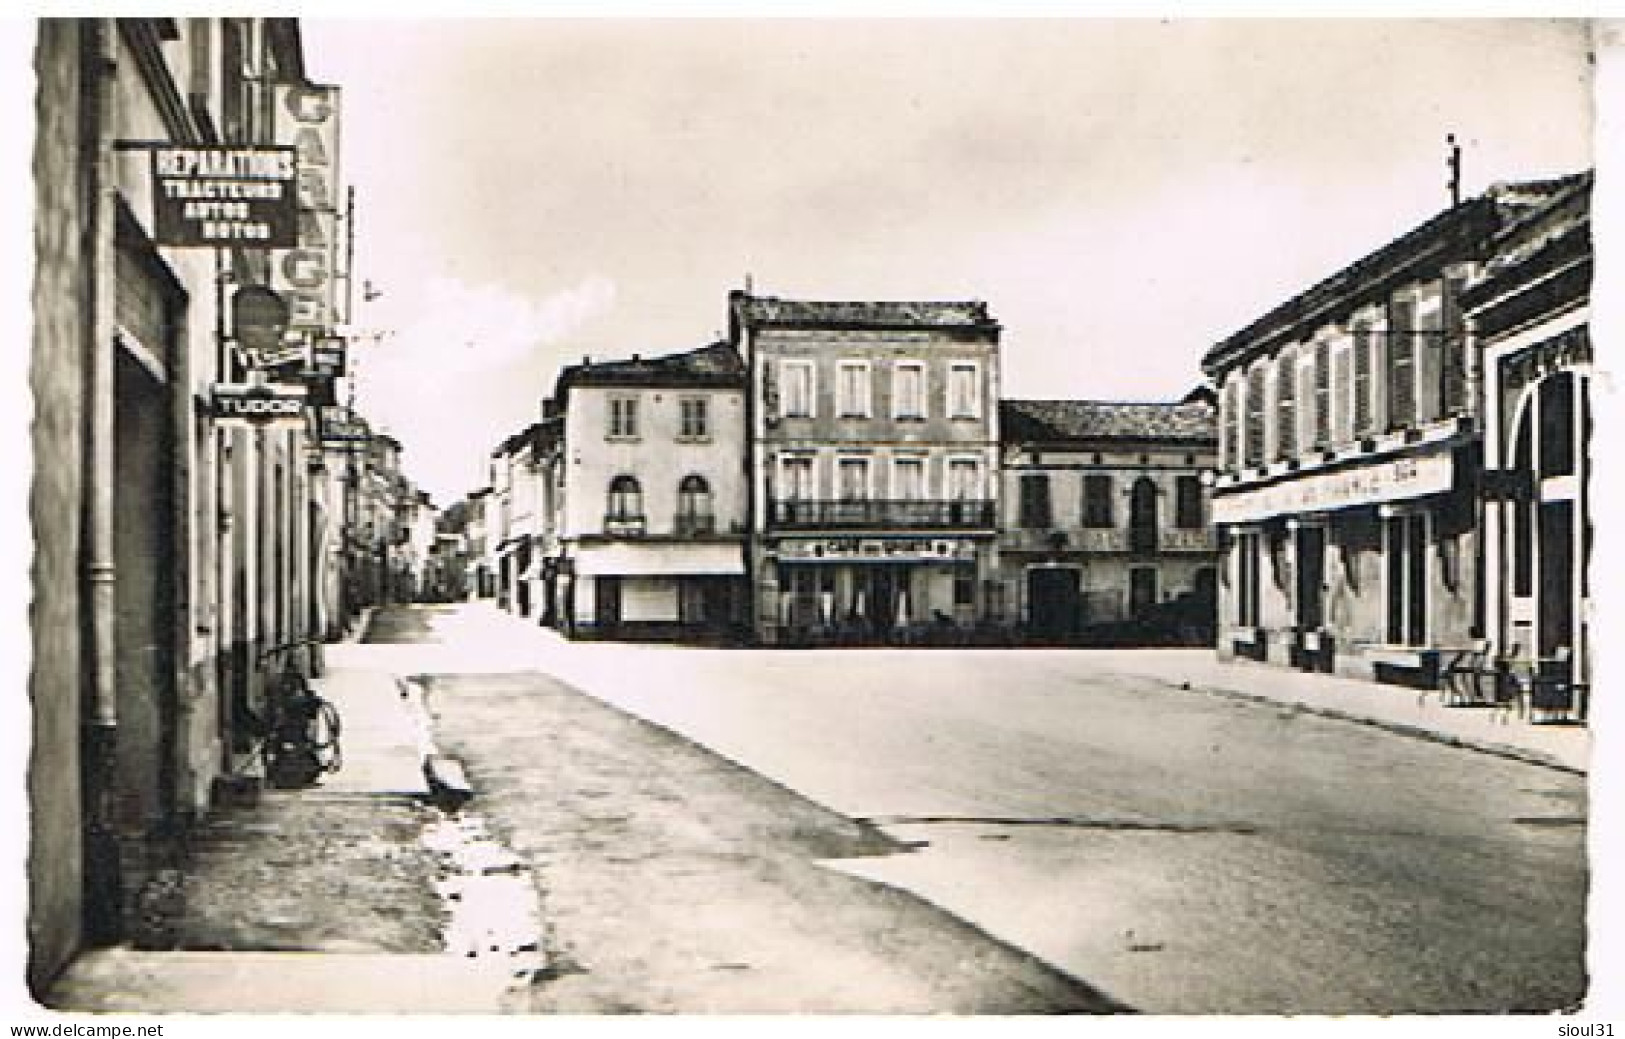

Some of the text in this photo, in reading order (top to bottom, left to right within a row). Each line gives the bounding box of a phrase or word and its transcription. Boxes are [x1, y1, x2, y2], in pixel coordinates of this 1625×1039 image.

[162, 180, 283, 198] TRACTEURS
[185, 202, 251, 218] AUTOS
[281, 87, 331, 326] GARAGE
[219, 399, 303, 413] TUDOR
